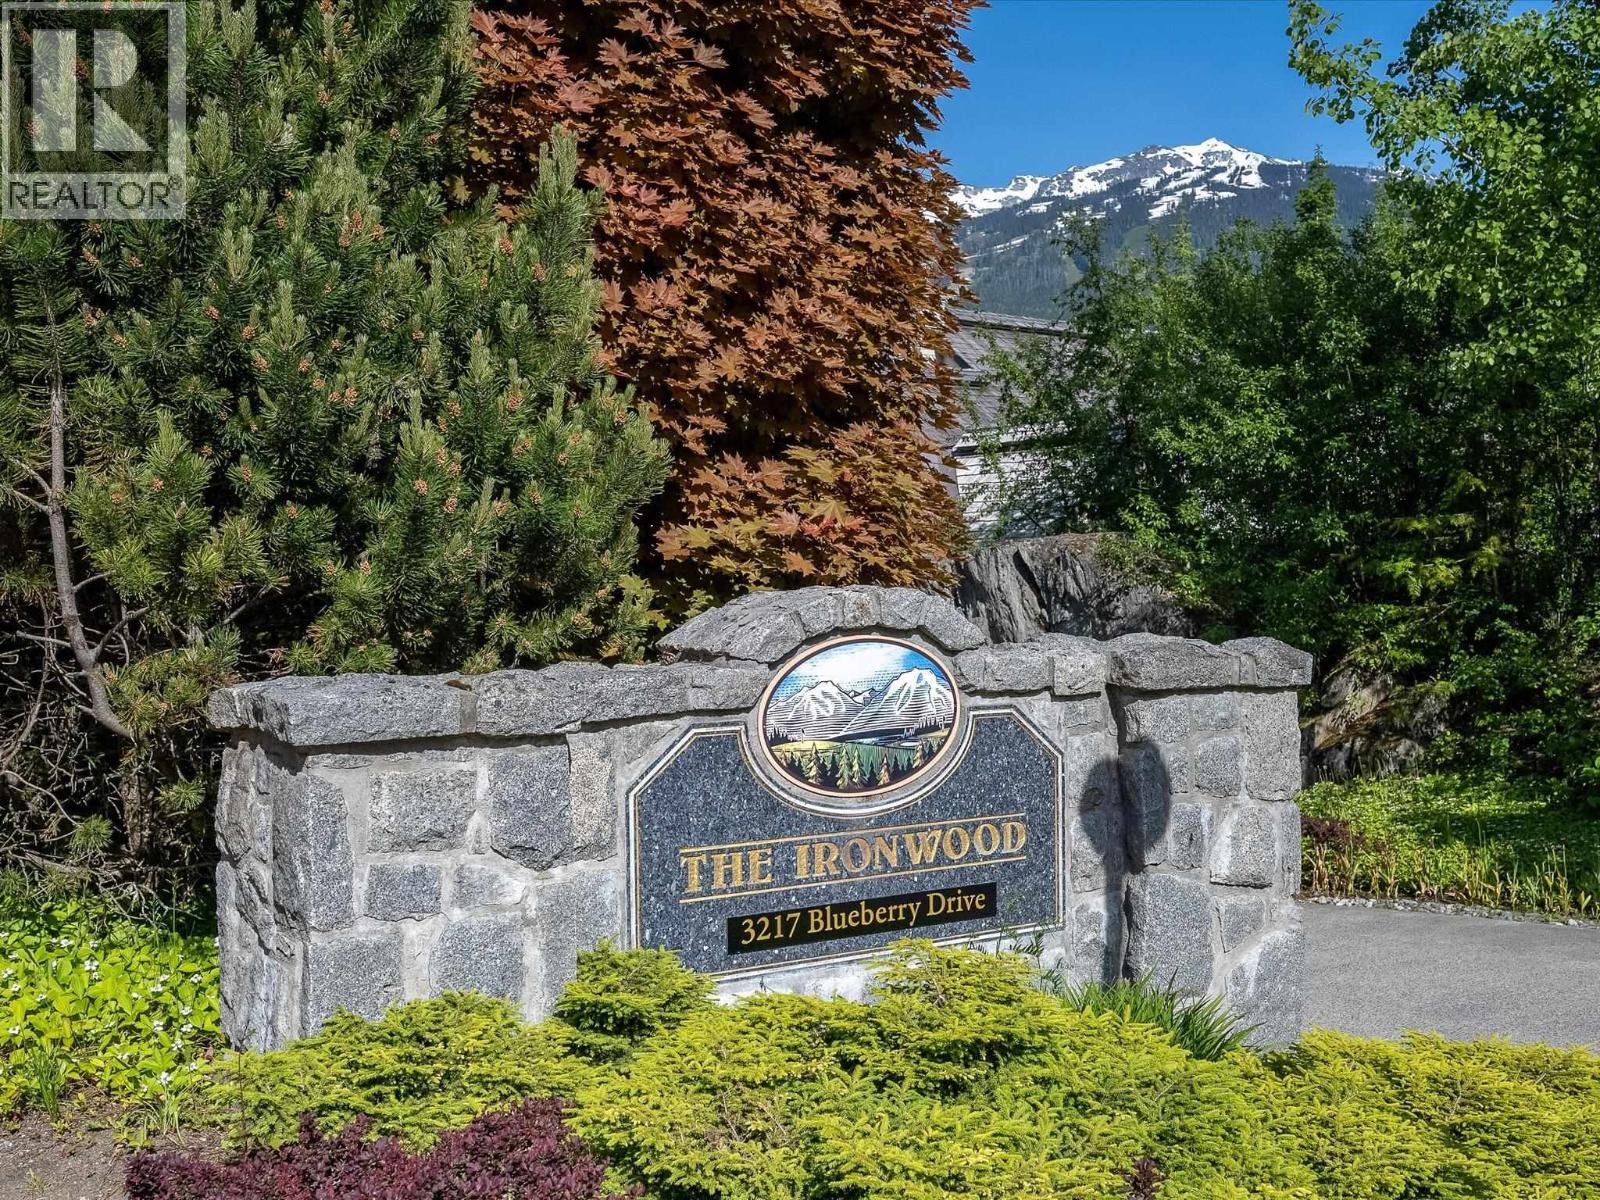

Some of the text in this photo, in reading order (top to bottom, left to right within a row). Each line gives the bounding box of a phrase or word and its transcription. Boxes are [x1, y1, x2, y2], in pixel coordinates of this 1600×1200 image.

[679, 820, 1027, 893] THE IRONWOOD
[740, 890, 987, 946] 3217 Blueberry Drive
